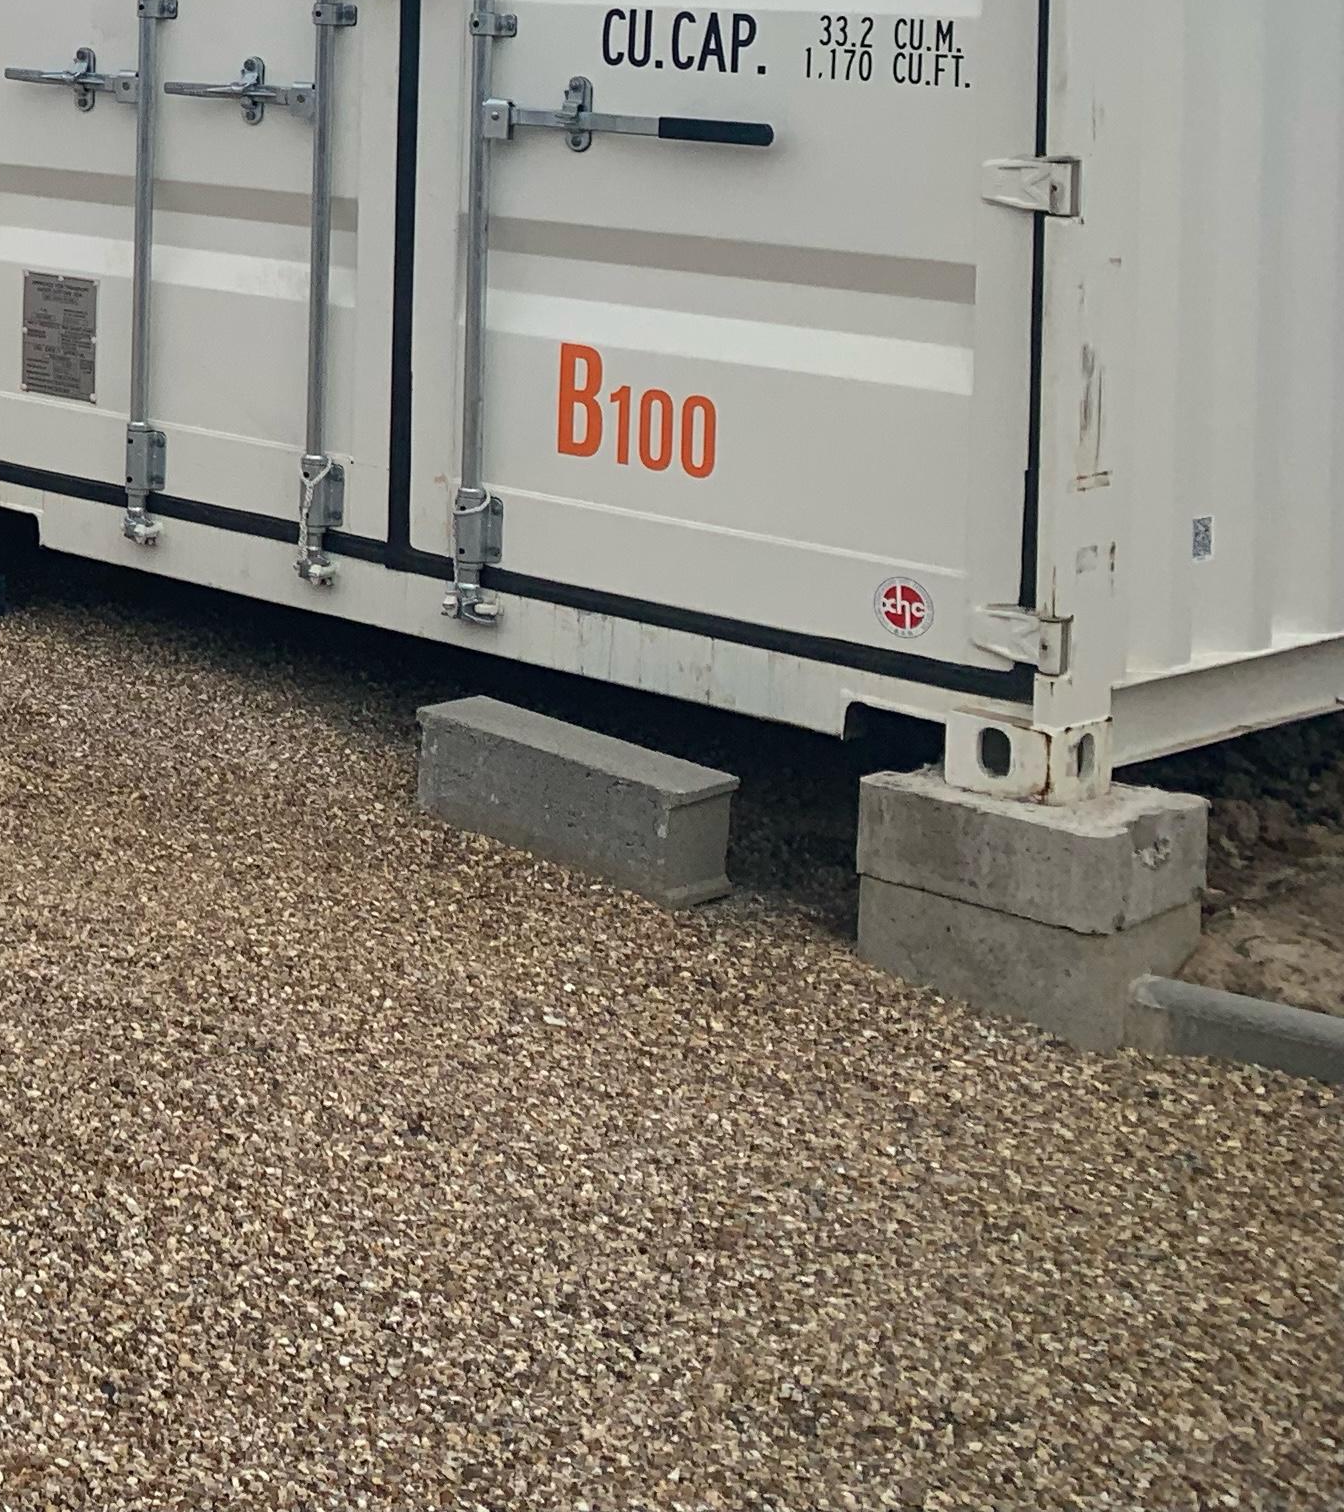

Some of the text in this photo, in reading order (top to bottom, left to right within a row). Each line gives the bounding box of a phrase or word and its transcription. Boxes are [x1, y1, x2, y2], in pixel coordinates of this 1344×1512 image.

[602, 8, 767, 75] CU.CAP.
[819, 15, 963, 53] 33.2 CU.M.
[805, 47, 971, 88] 1,170 CU.FT.
[557, 342, 718, 479] B100
